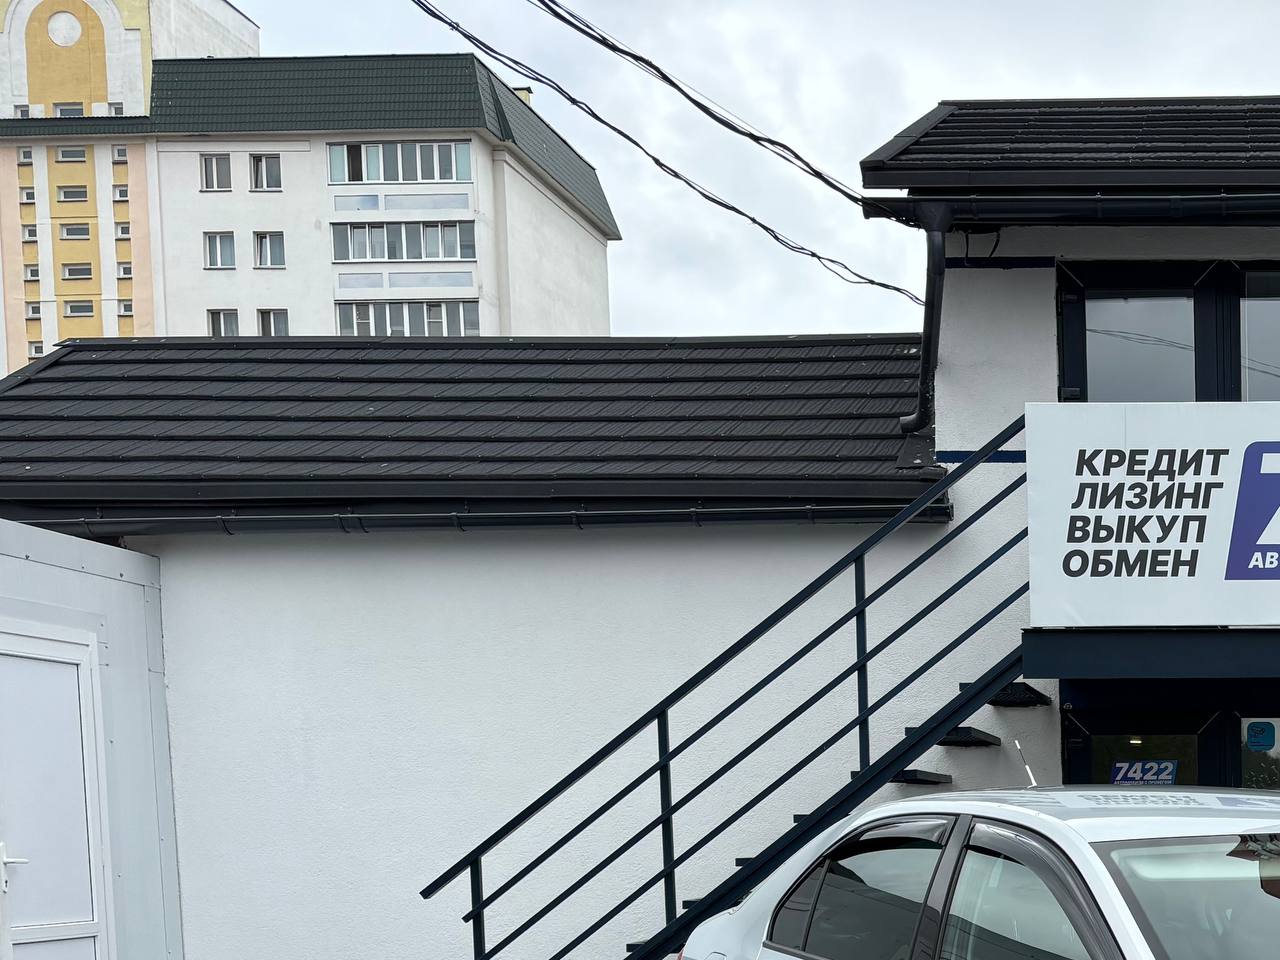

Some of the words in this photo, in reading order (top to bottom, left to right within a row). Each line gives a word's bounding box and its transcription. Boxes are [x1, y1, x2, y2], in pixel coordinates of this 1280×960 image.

[1075, 448, 1230, 482] КРЕДИТ
[1070, 481, 1225, 510] ЛИЗИНГ
[1066, 514, 1208, 544] ВЫКУП
[1062, 548, 1200, 578] ОБМЕН
[1114, 761, 1174, 781] 7422
